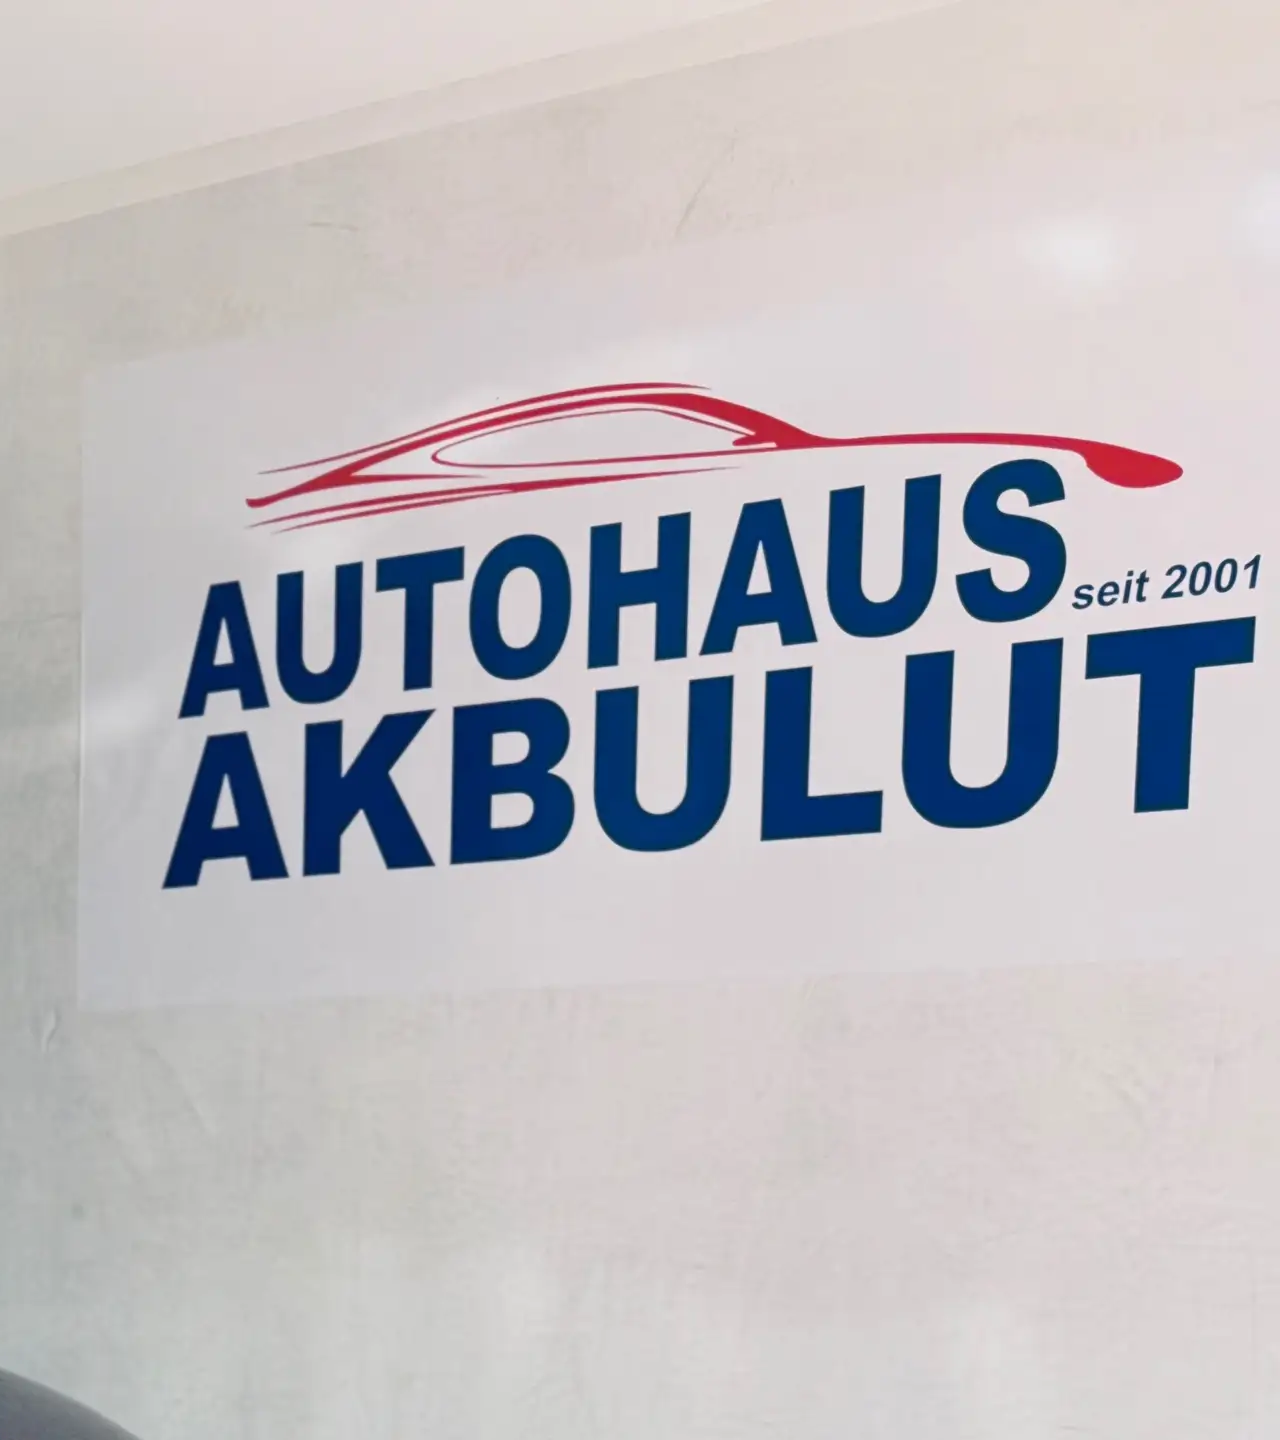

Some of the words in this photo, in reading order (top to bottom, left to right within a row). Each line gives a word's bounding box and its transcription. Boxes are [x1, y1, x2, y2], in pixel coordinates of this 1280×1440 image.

[178, 458, 1067, 719] AUTOHAUS
[1071, 569, 1150, 610] seit
[1161, 553, 1262, 600] 2001
[162, 616, 1258, 890] AKBULUT
